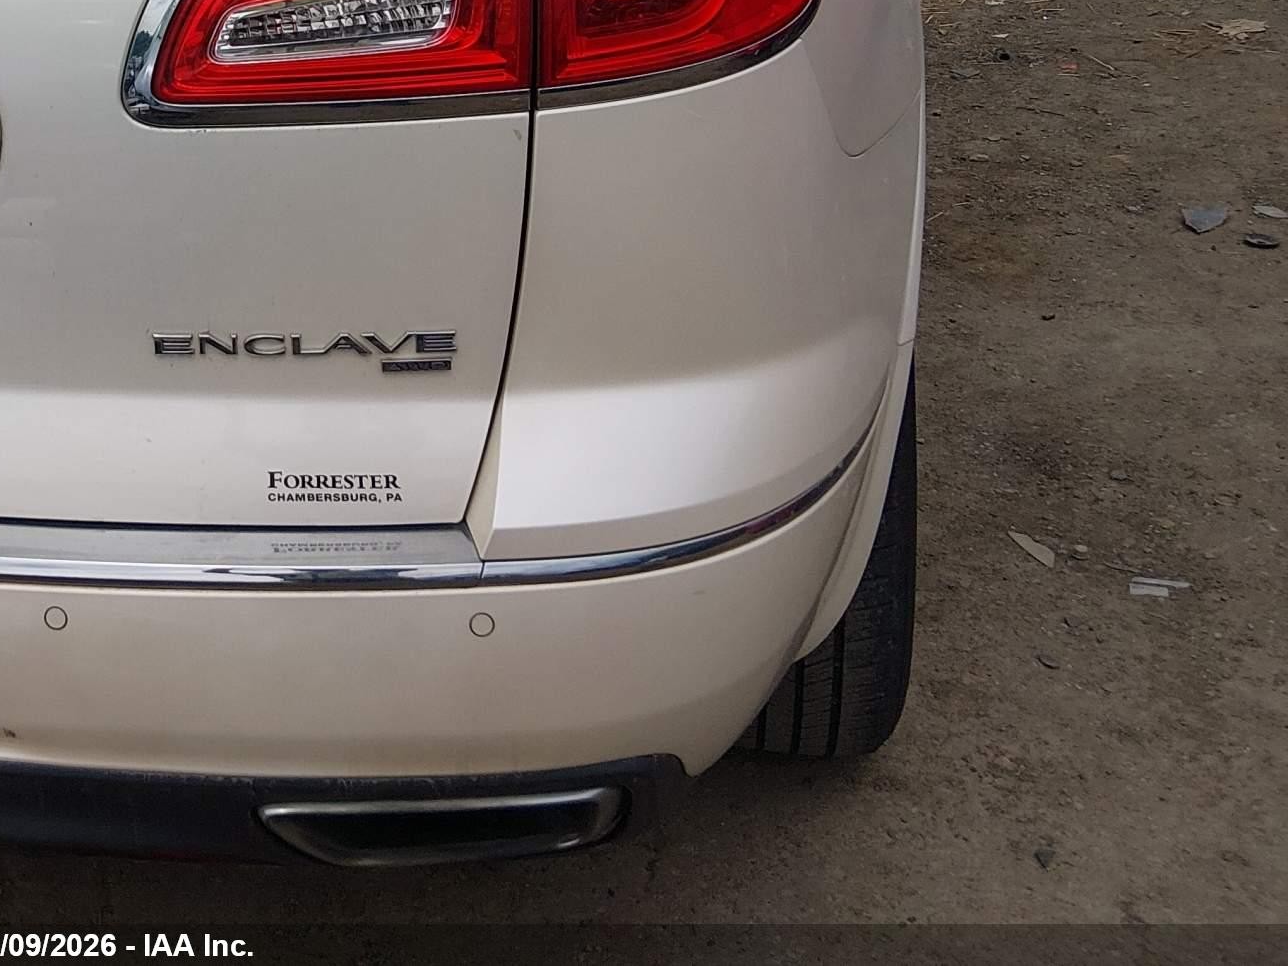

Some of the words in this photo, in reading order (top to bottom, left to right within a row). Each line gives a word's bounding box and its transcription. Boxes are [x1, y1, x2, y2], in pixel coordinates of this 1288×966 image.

[152, 330, 458, 355] ENCLAVE
[267, 493, 382, 503] CHAMBERSBURG,
[386, 493, 403, 502] PA
